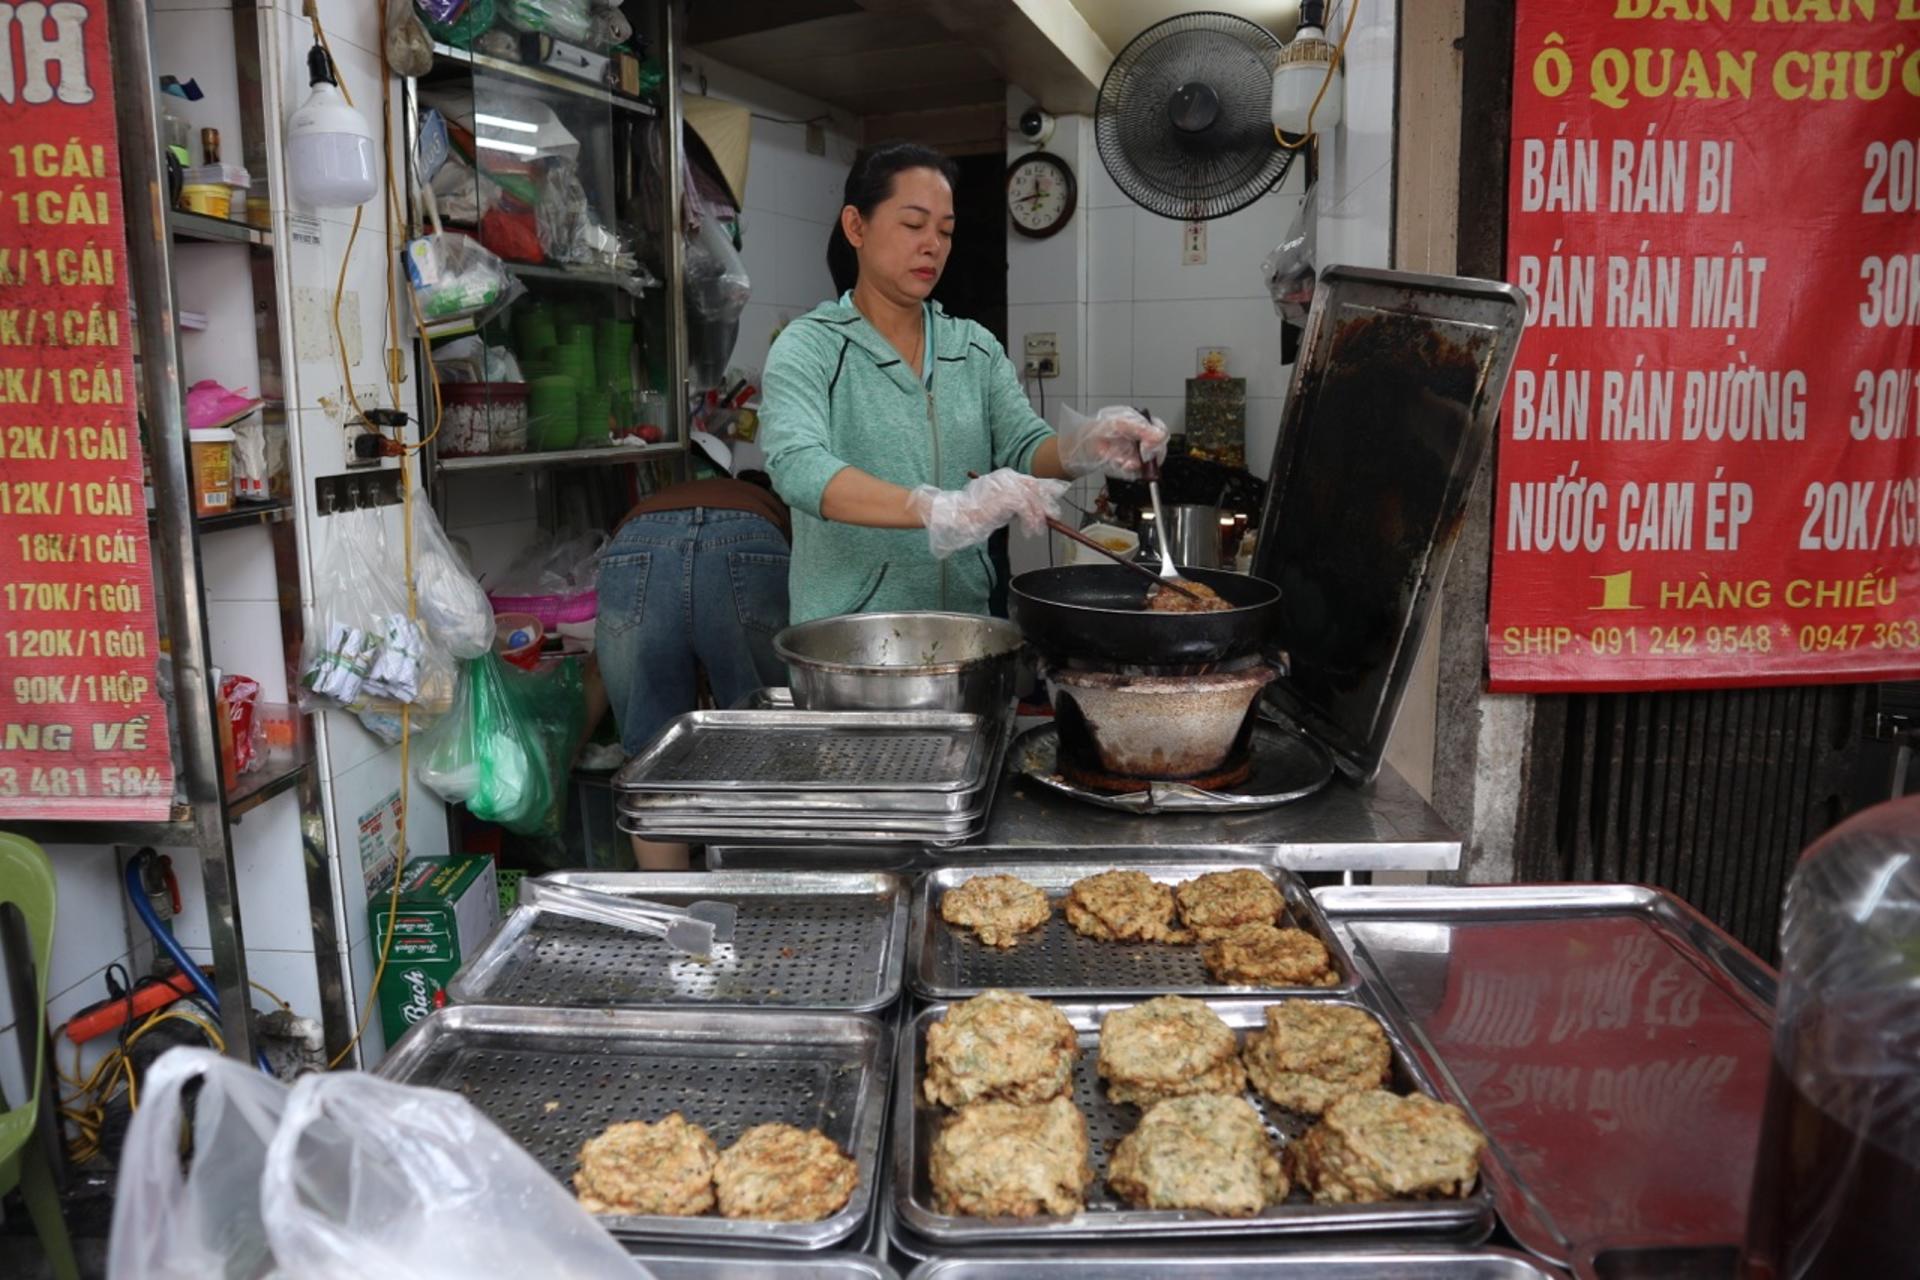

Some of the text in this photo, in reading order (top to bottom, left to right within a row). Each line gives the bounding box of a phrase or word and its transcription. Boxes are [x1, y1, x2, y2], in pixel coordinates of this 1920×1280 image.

[0, 2, 94, 104] H
[1533, 32, 1573, 97] Ô
[1590, 48, 1757, 109] QUAN
[0, 185, 109, 225] 1CÁI
[1521, 122, 1920, 214] BÁN RÁN BI 20
[1519, 239, 1595, 327] BÁN
[1606, 240, 1681, 327] RÁN
[1691, 241, 1767, 345] MẬT
[1512, 353, 1590, 441] BÁN
[1601, 354, 1674, 441] RÁN
[1681, 351, 1807, 442] ĐƯỜNG
[1506, 461, 1920, 553] NƯỚC CAM ÉP 20K/1C
[1588, 567, 1898, 611] 1 HÀNG CHIẾU
[1591, 626, 1637, 655] 091
[1650, 626, 1698, 654] 242
[1706, 625, 1772, 653] 9548
[1800, 624, 1865, 653] 0947
[0, 723, 73, 750] NG
[30, 766, 88, 797] 481
[101, 766, 162, 797] 584
